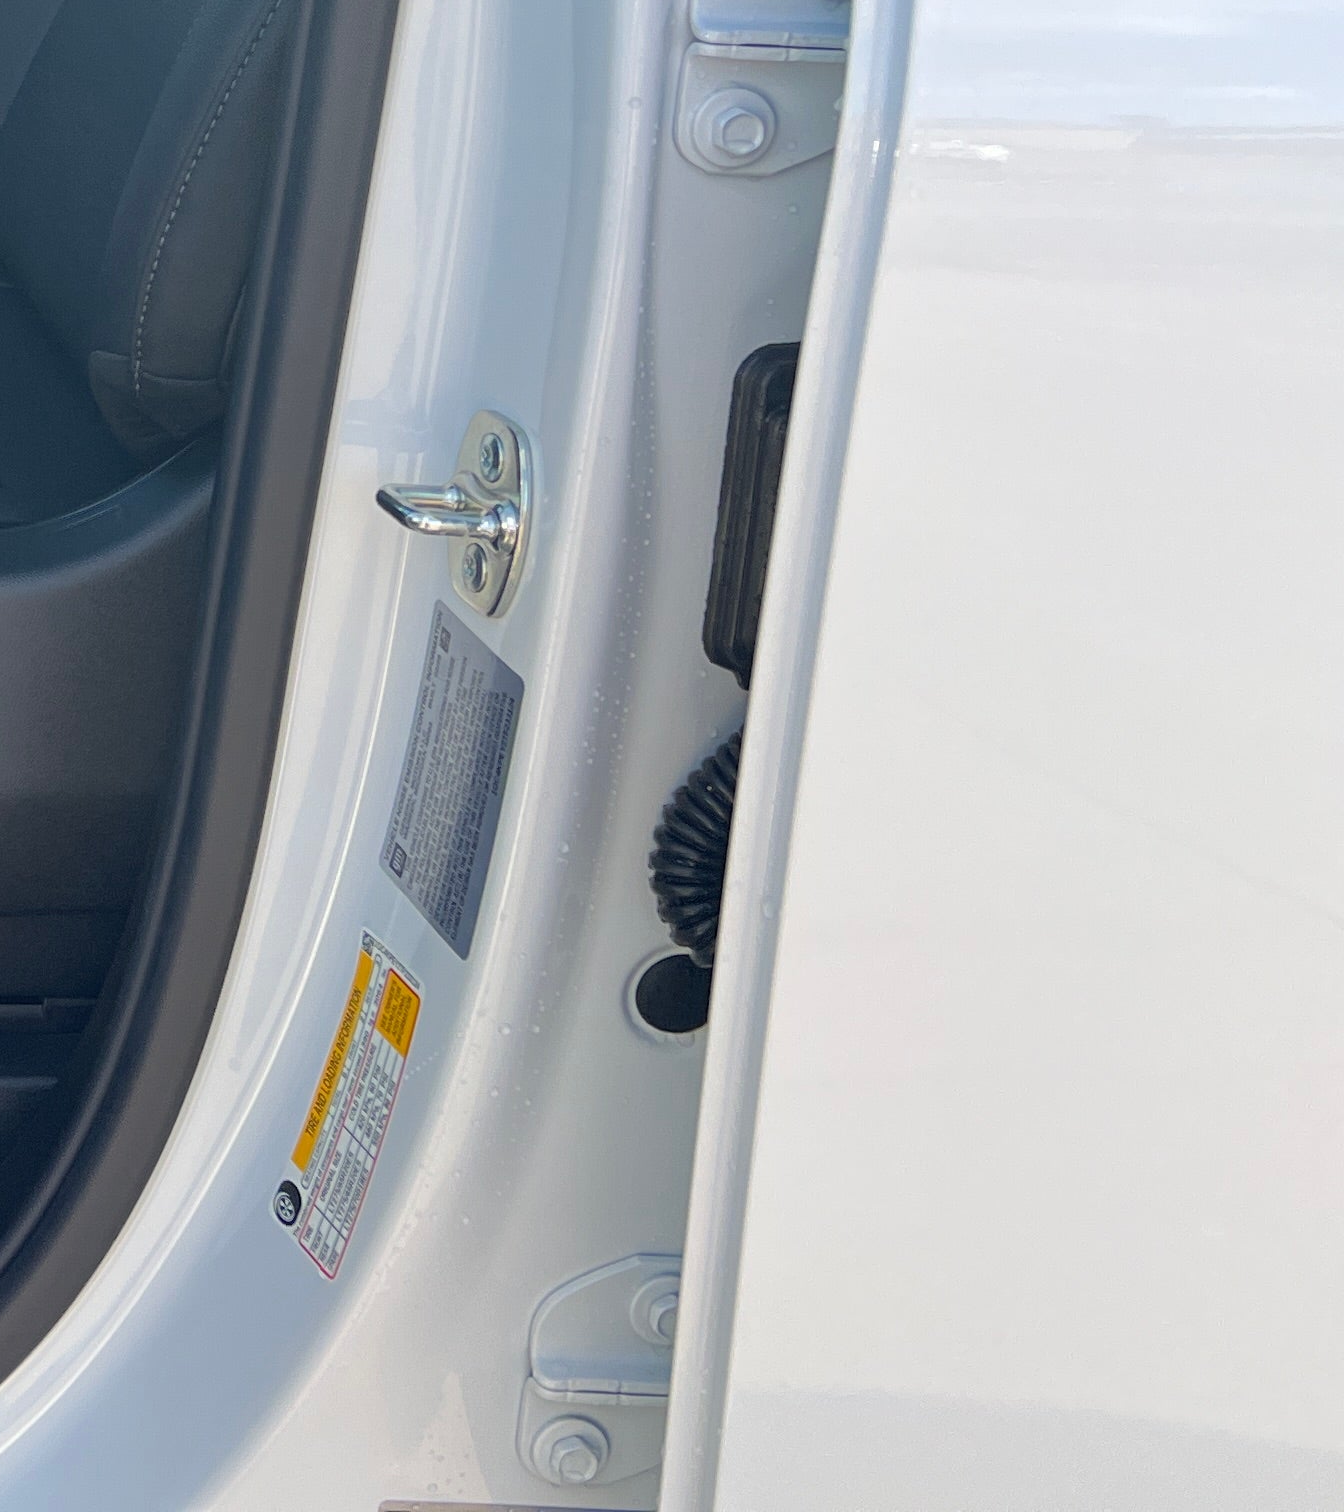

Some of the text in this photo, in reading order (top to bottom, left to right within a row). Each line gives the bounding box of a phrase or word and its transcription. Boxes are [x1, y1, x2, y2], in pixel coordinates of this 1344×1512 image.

[306, 989, 361, 1136] TIRE AND LOADING INFORMATION
